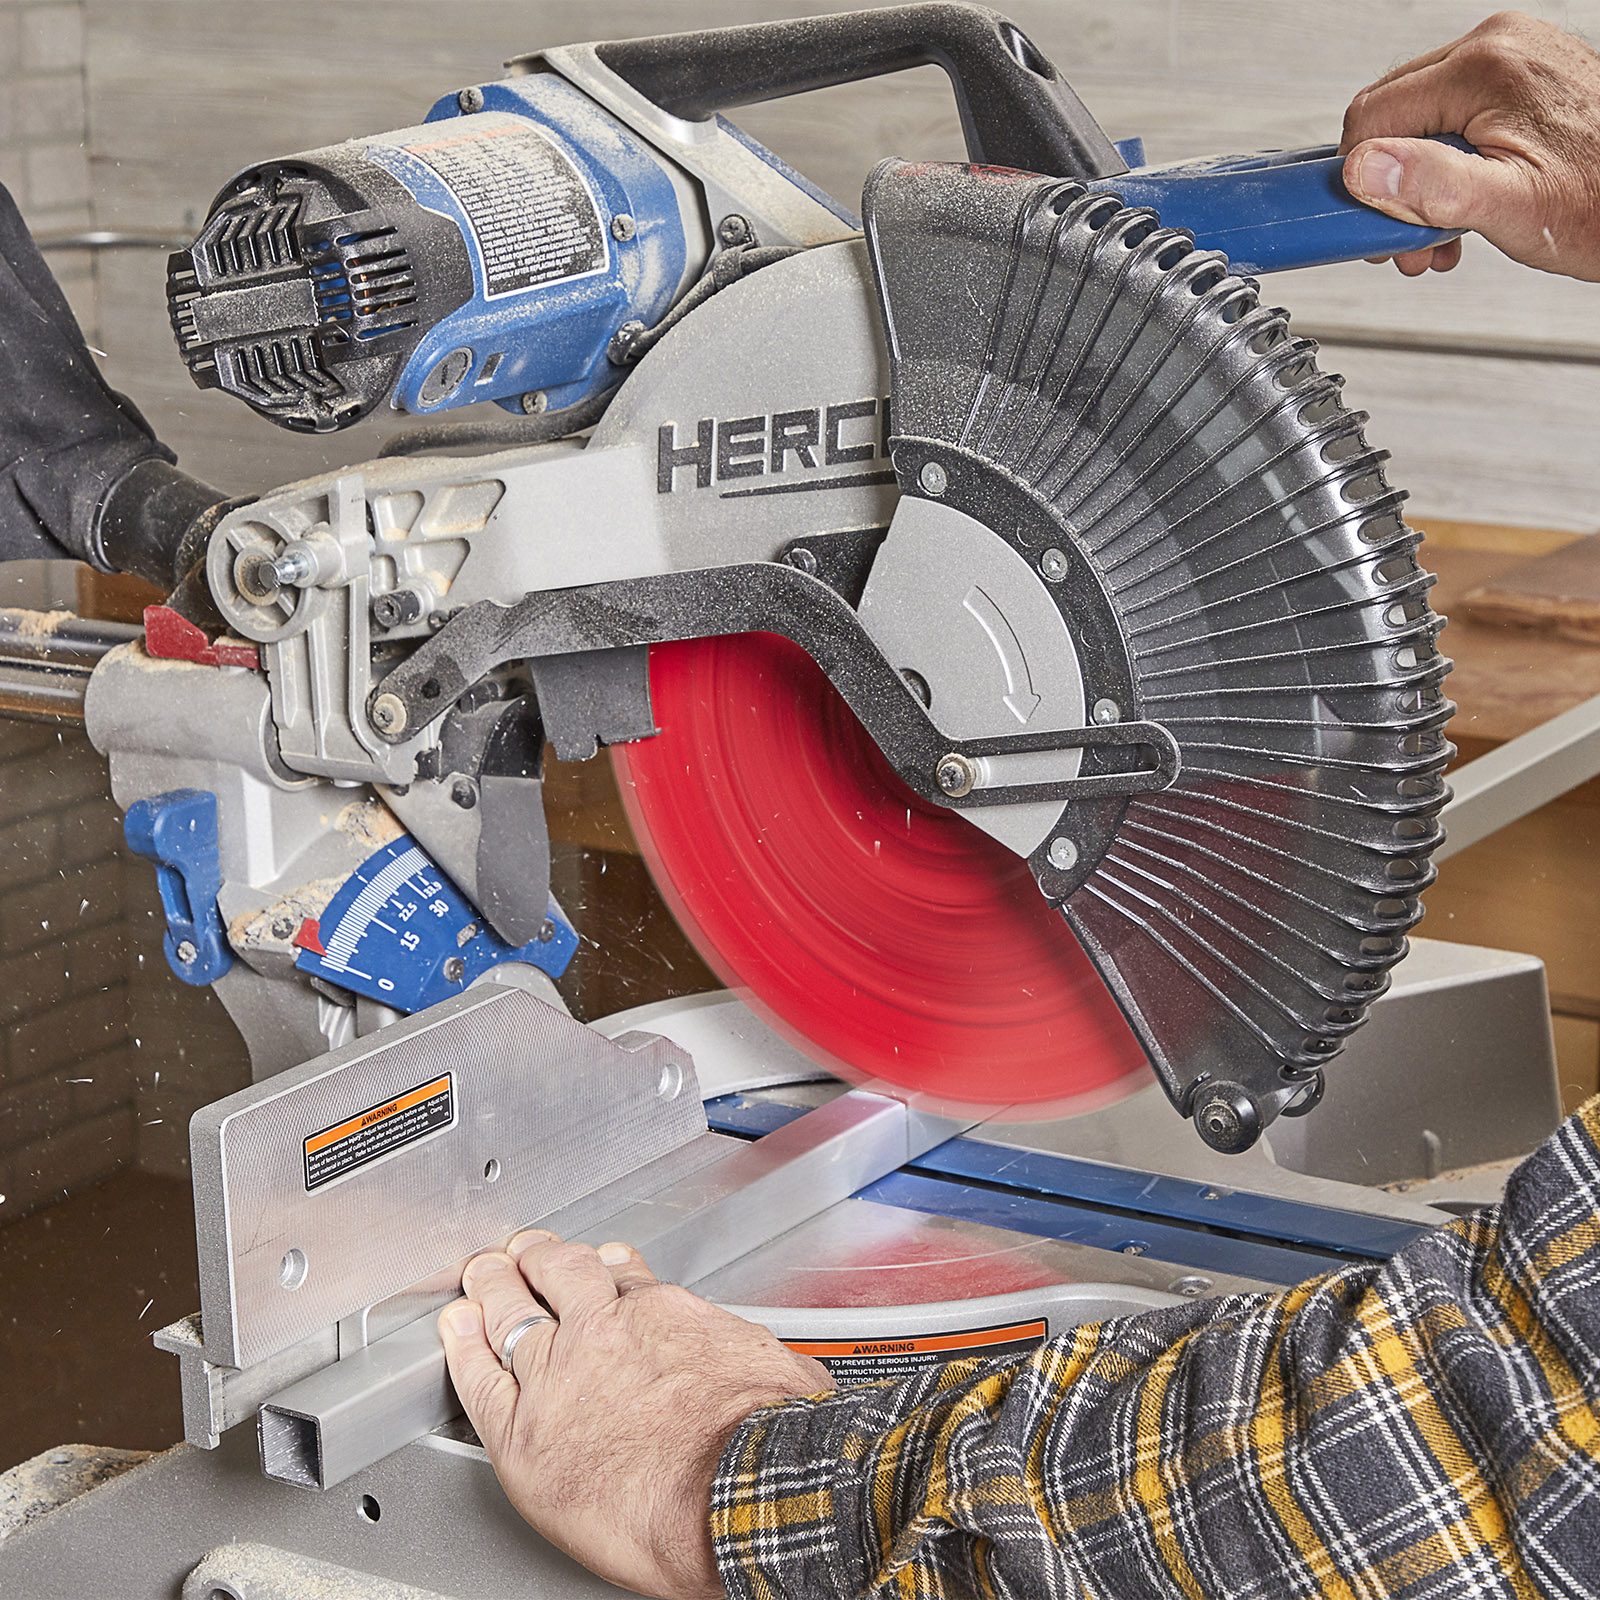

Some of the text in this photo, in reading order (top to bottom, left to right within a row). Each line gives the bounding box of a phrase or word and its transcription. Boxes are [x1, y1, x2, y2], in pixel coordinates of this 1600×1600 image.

[658, 397, 891, 494] HERC
[423, 881, 442, 897] 33.9
[398, 902, 417, 922] 22.5
[428, 899, 449, 918] 30
[400, 931, 420, 951] 15
[378, 978, 395, 991] 0
[365, 1103, 397, 1123] WARNING
[862, 1343, 915, 1353] WARNING
[877, 1357, 909, 1365] SERIOUS
[911, 1355, 938, 1363] INJURY:
[837, 1368, 885, 1376] INSTRUCTION
[887, 1366, 917, 1374] MANUAL
